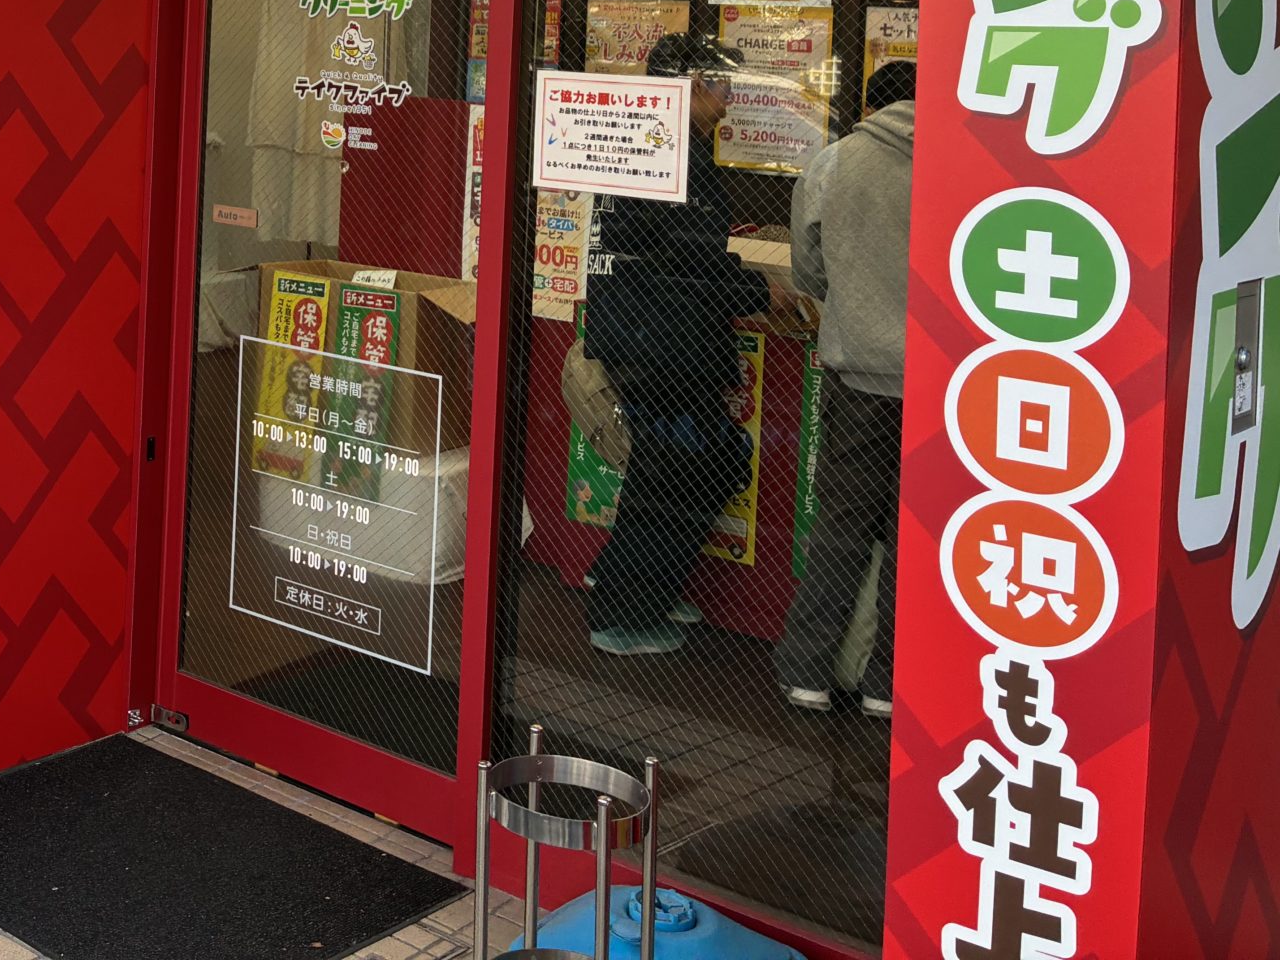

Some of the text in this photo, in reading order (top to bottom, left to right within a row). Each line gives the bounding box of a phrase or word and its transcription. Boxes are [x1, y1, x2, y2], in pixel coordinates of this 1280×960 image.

[737, 37, 785, 50] CHARGE
[293, 76, 412, 108] テイクファイブ
[549, 89, 672, 110] ご協力お願いします!
[558, 107, 660, 121] お品物の仕上り日から2週間以内に
[573, 118, 643, 130] お引き取りお願いします
[584, 132, 634, 143] 2週間過ぎた場合
[562, 142, 656, 157] 1点につき1日10円の保管料が
[585, 152, 630, 164] 発生いたします
[546, 160, 672, 179] なるべくお早めのお引き取りお願い致します
[217, 209, 239, 221] Auto
[534, 243, 579, 271] 00円
[279, 279, 324, 294] 新メニュー
[345, 291, 394, 306] 新メニュー
[309, 373, 363, 399] 営業時間
[294, 403, 375, 436] 平日(月〜金)
[251, 419, 419, 477] 10:00 13:00 15:00 19:00
[325, 471, 339, 488] 土
[291, 487, 370, 525] 10:00 19:00
[307, 523, 352, 550] 日・祝日
[288, 545, 367, 584] 10:00 19:00
[285, 585, 369, 626] 定休日:火・水
